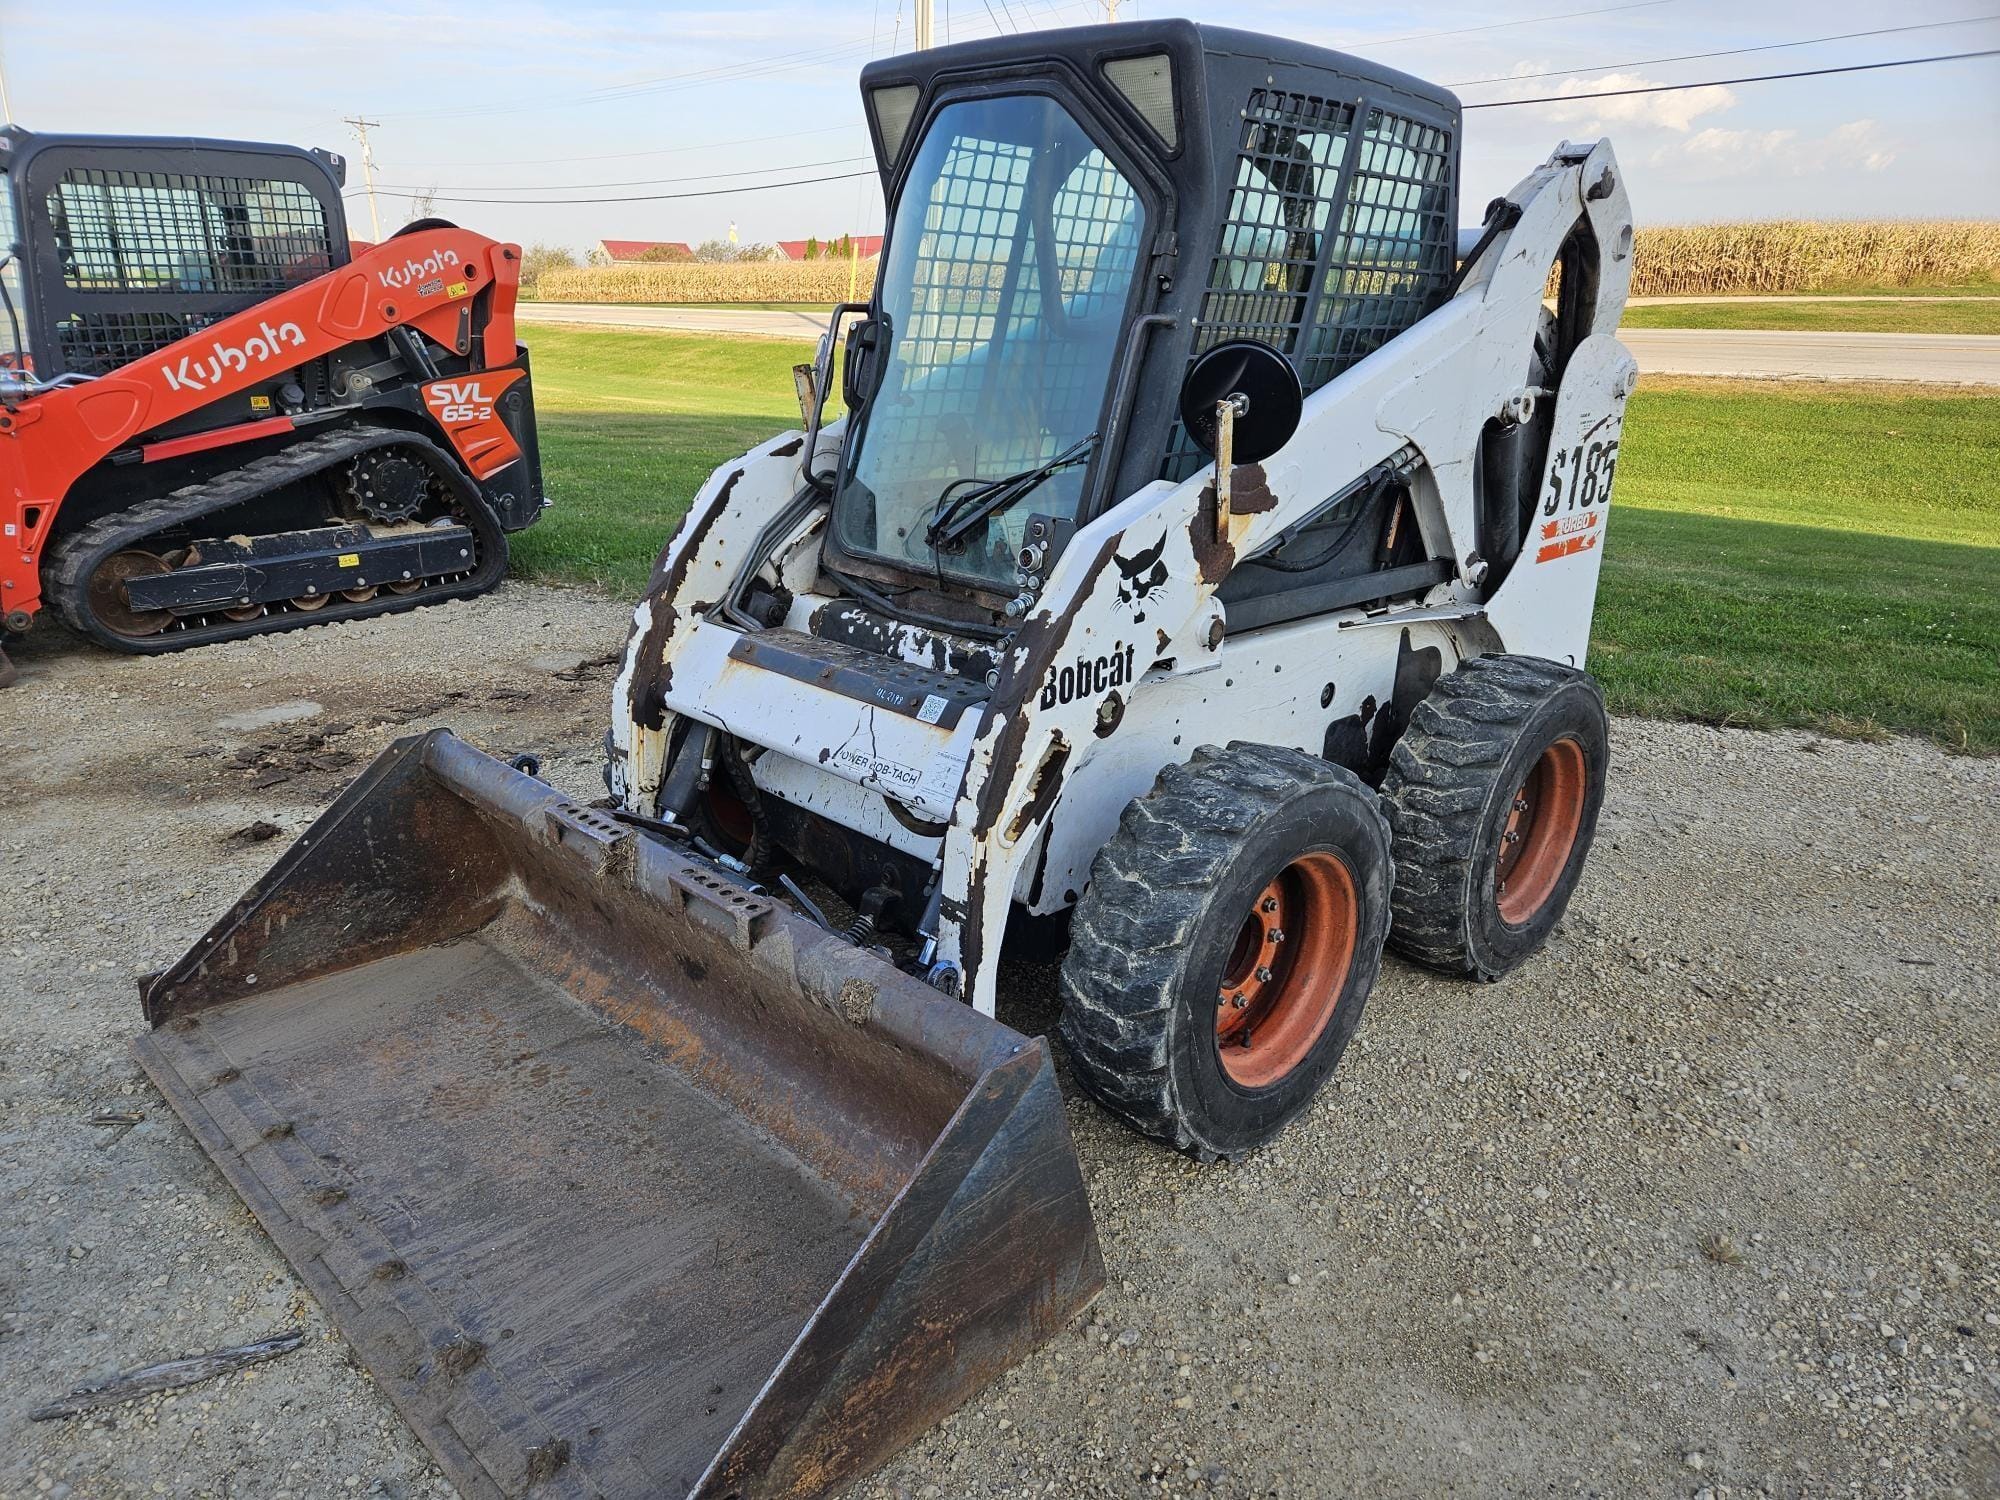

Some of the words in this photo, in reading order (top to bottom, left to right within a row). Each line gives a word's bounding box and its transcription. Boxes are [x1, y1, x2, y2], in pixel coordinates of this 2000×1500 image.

[378, 249, 460, 288] Kubota
[161, 321, 306, 391] Kubota
[428, 382, 493, 406] SVL
[441, 404, 492, 422] 65-2
[1543, 440, 1619, 517] S185
[1040, 643, 1135, 712] Bobcat
